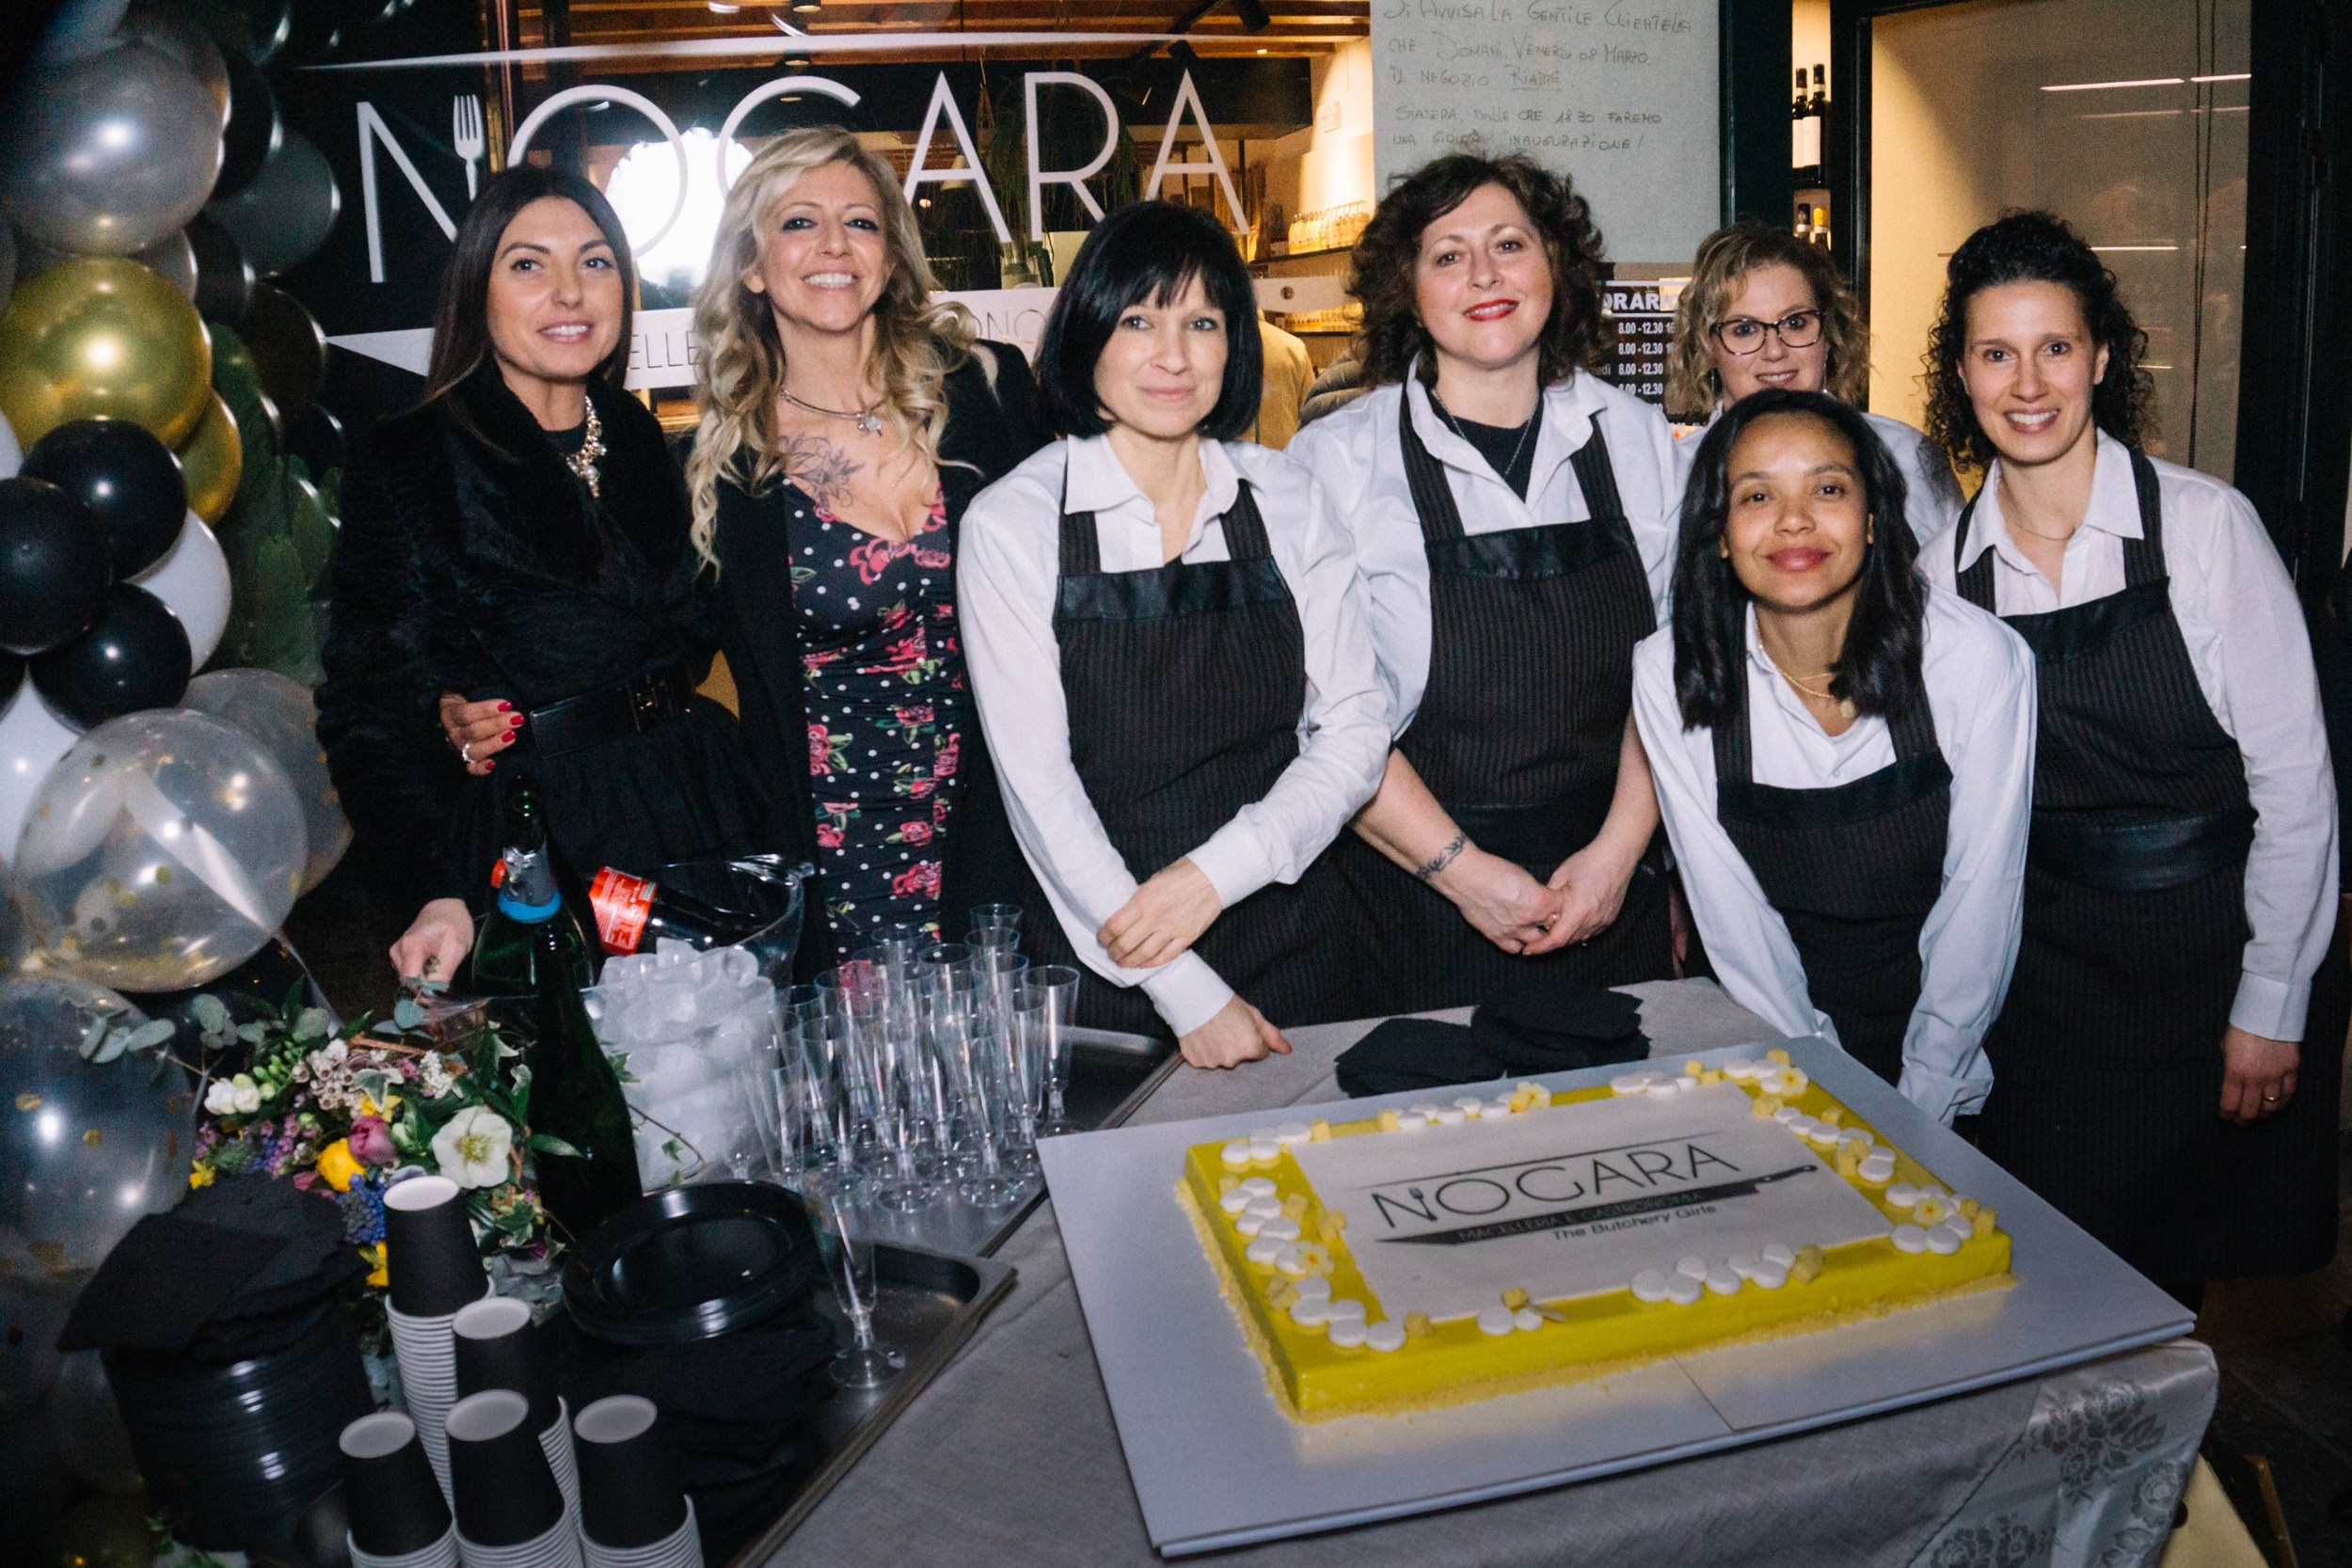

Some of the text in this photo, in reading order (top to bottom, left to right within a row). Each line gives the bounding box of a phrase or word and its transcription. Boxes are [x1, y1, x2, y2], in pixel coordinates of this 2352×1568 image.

[1371, 1143, 1742, 1229] NOGARA
[1553, 1204, 1717, 1241] The Butchery Girls
